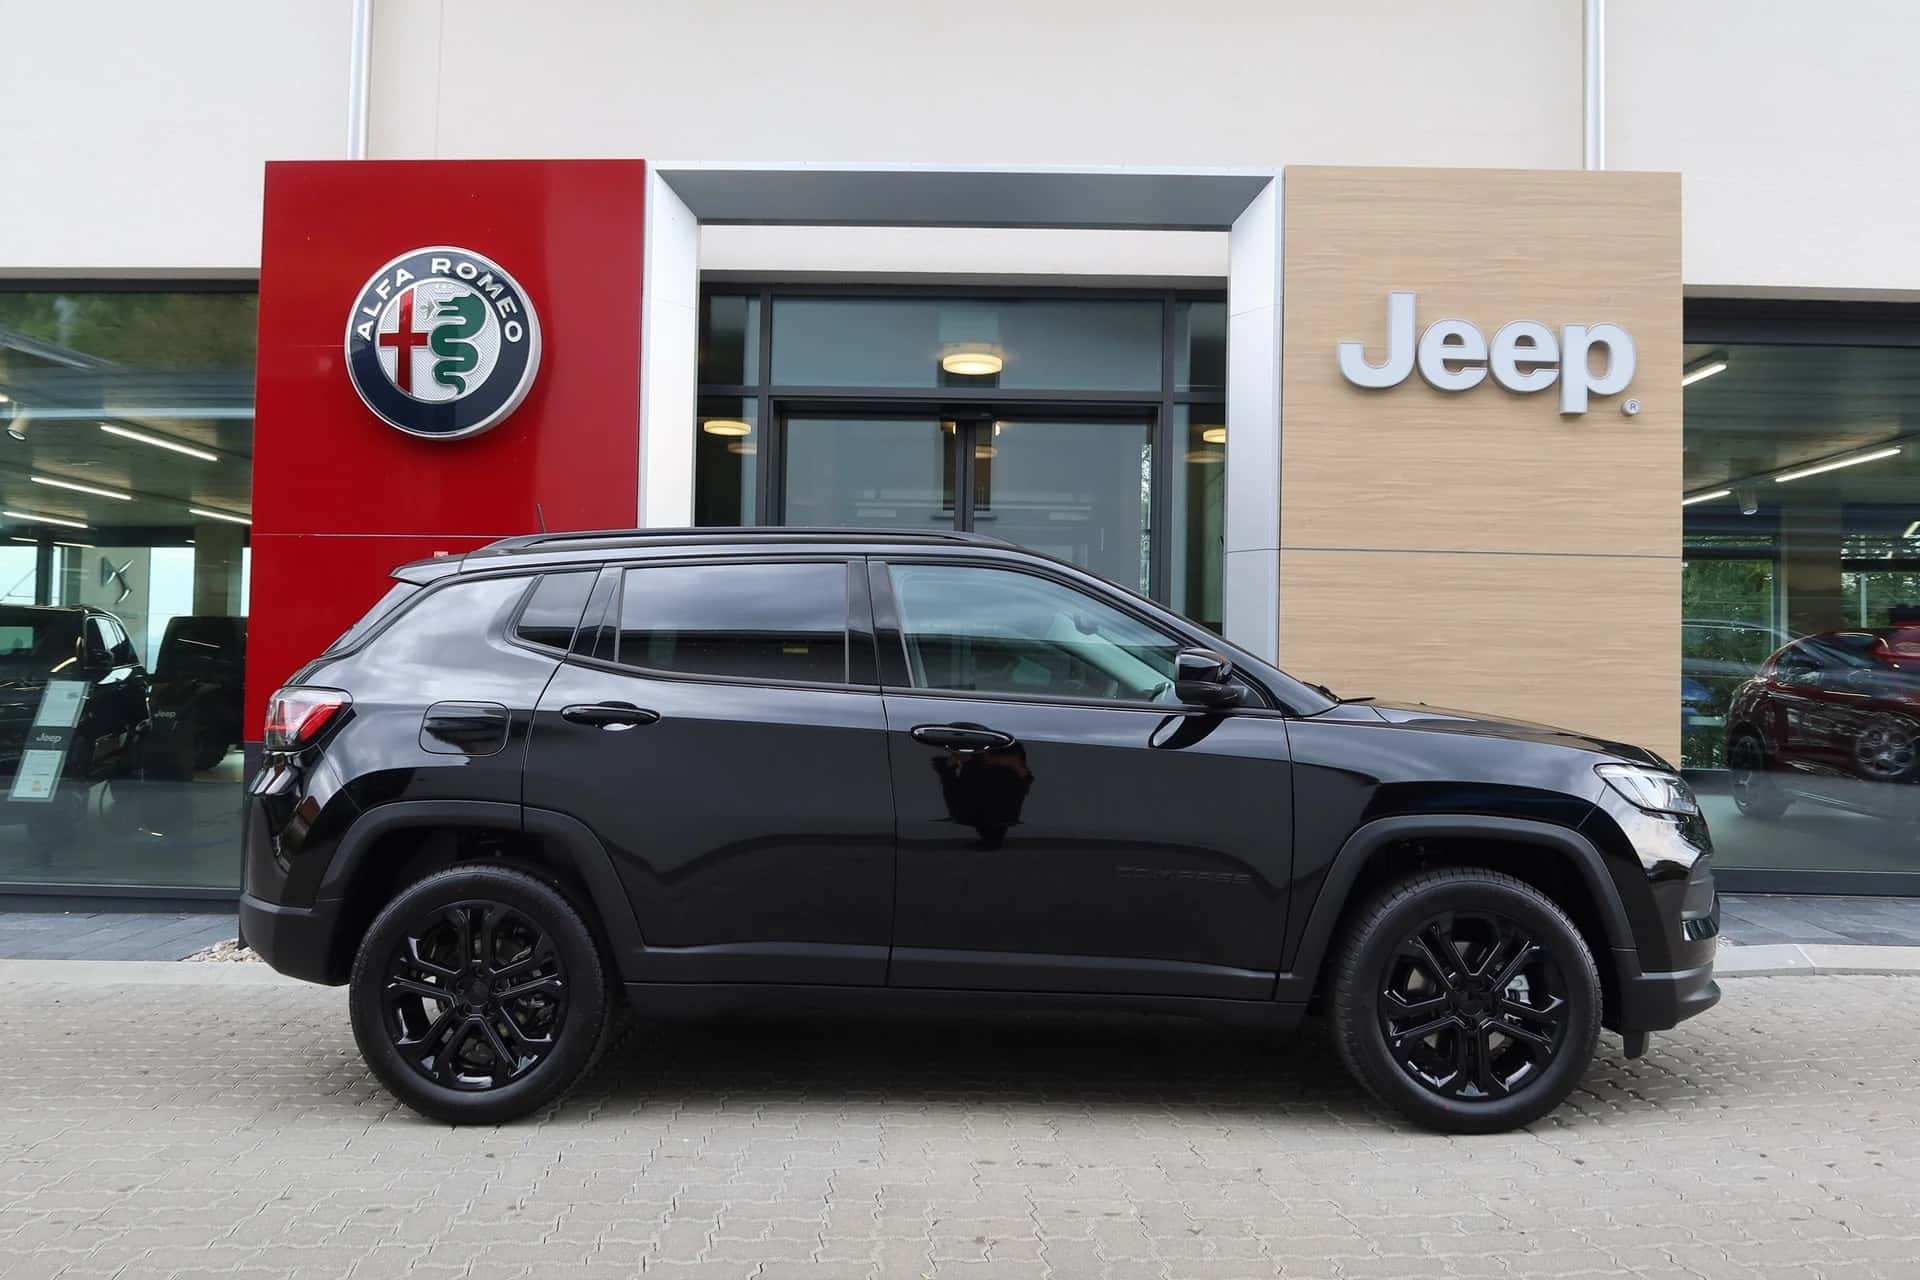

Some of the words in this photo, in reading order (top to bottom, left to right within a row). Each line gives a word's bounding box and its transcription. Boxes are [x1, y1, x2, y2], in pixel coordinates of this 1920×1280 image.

[357, 268, 415, 341] ALFA
[431, 258, 522, 342] ROMEO
[1338, 291, 1636, 416] Jeep
[36, 732, 62, 744] Jeep
[154, 709, 176, 719] Jeep
